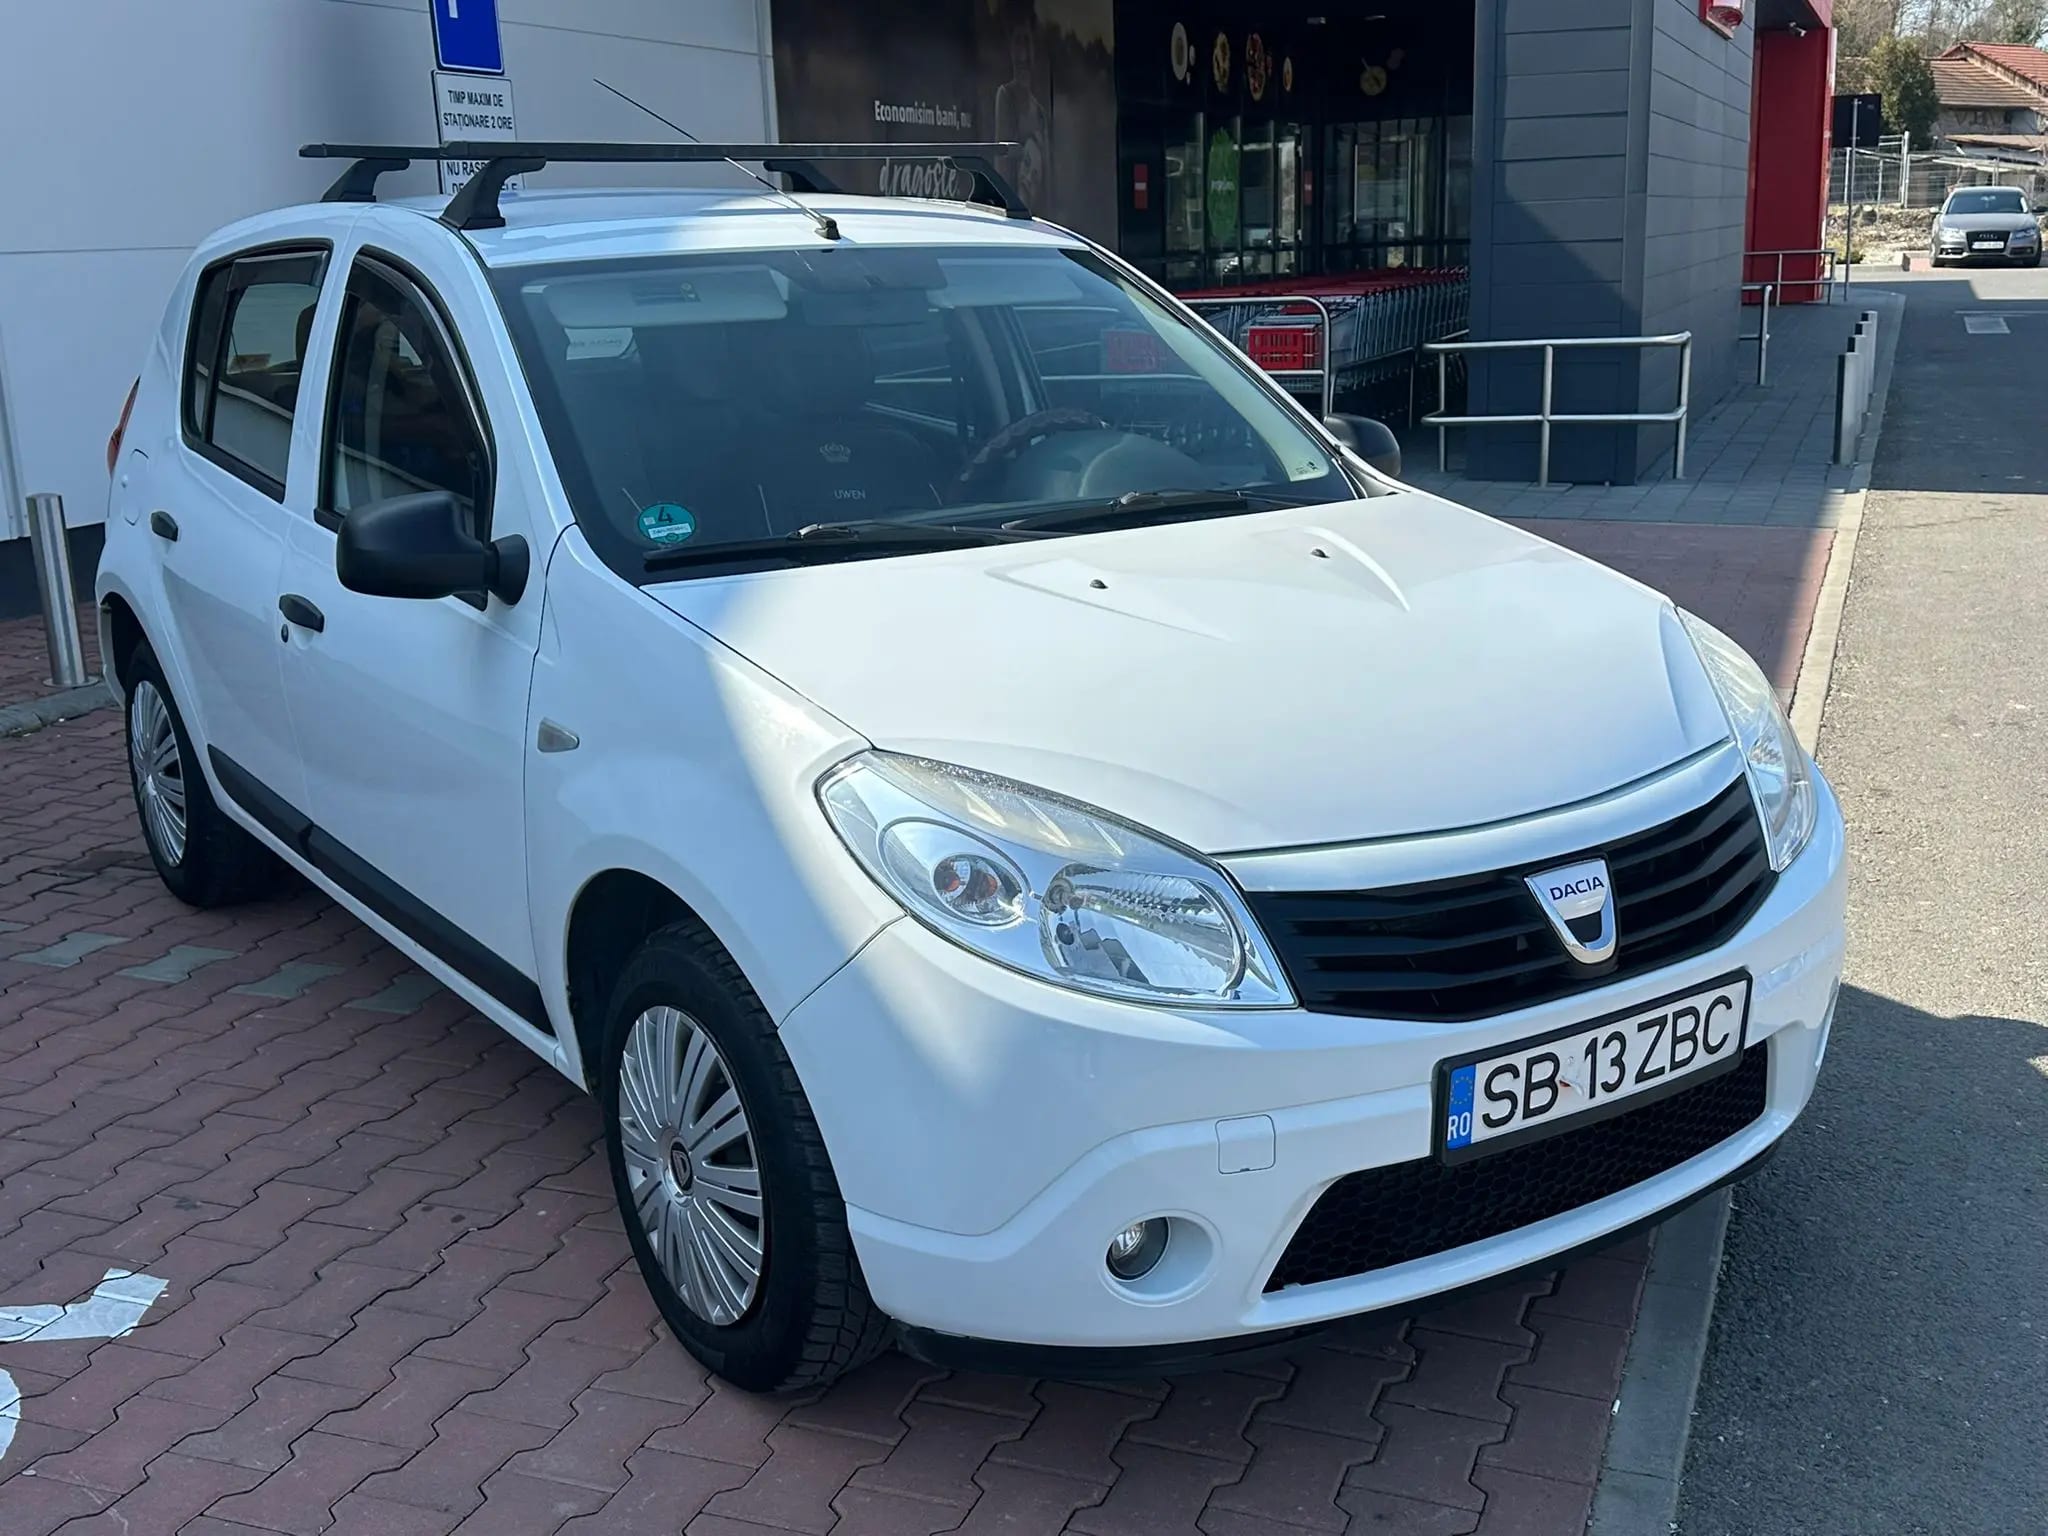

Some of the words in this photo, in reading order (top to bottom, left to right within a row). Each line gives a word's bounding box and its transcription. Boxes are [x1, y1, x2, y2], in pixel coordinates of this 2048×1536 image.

[448, 90, 465, 104] TIMP
[467, 91, 492, 106] MAXIM
[493, 94, 504, 107] DE
[491, 115, 496, 129] 2
[497, 116, 513, 130] ORE
[874, 100, 935, 125] Economisim
[936, 104, 960, 130] bani,
[446, 161, 460, 175] NU
[658, 506, 673, 523] 4
[1549, 876, 1605, 901] DACIA
[1482, 1052, 1561, 1129] SB
[1584, 1030, 1627, 1100] 13
[1635, 995, 1733, 1085] ZBC
[1447, 1111, 1471, 1142] RO
